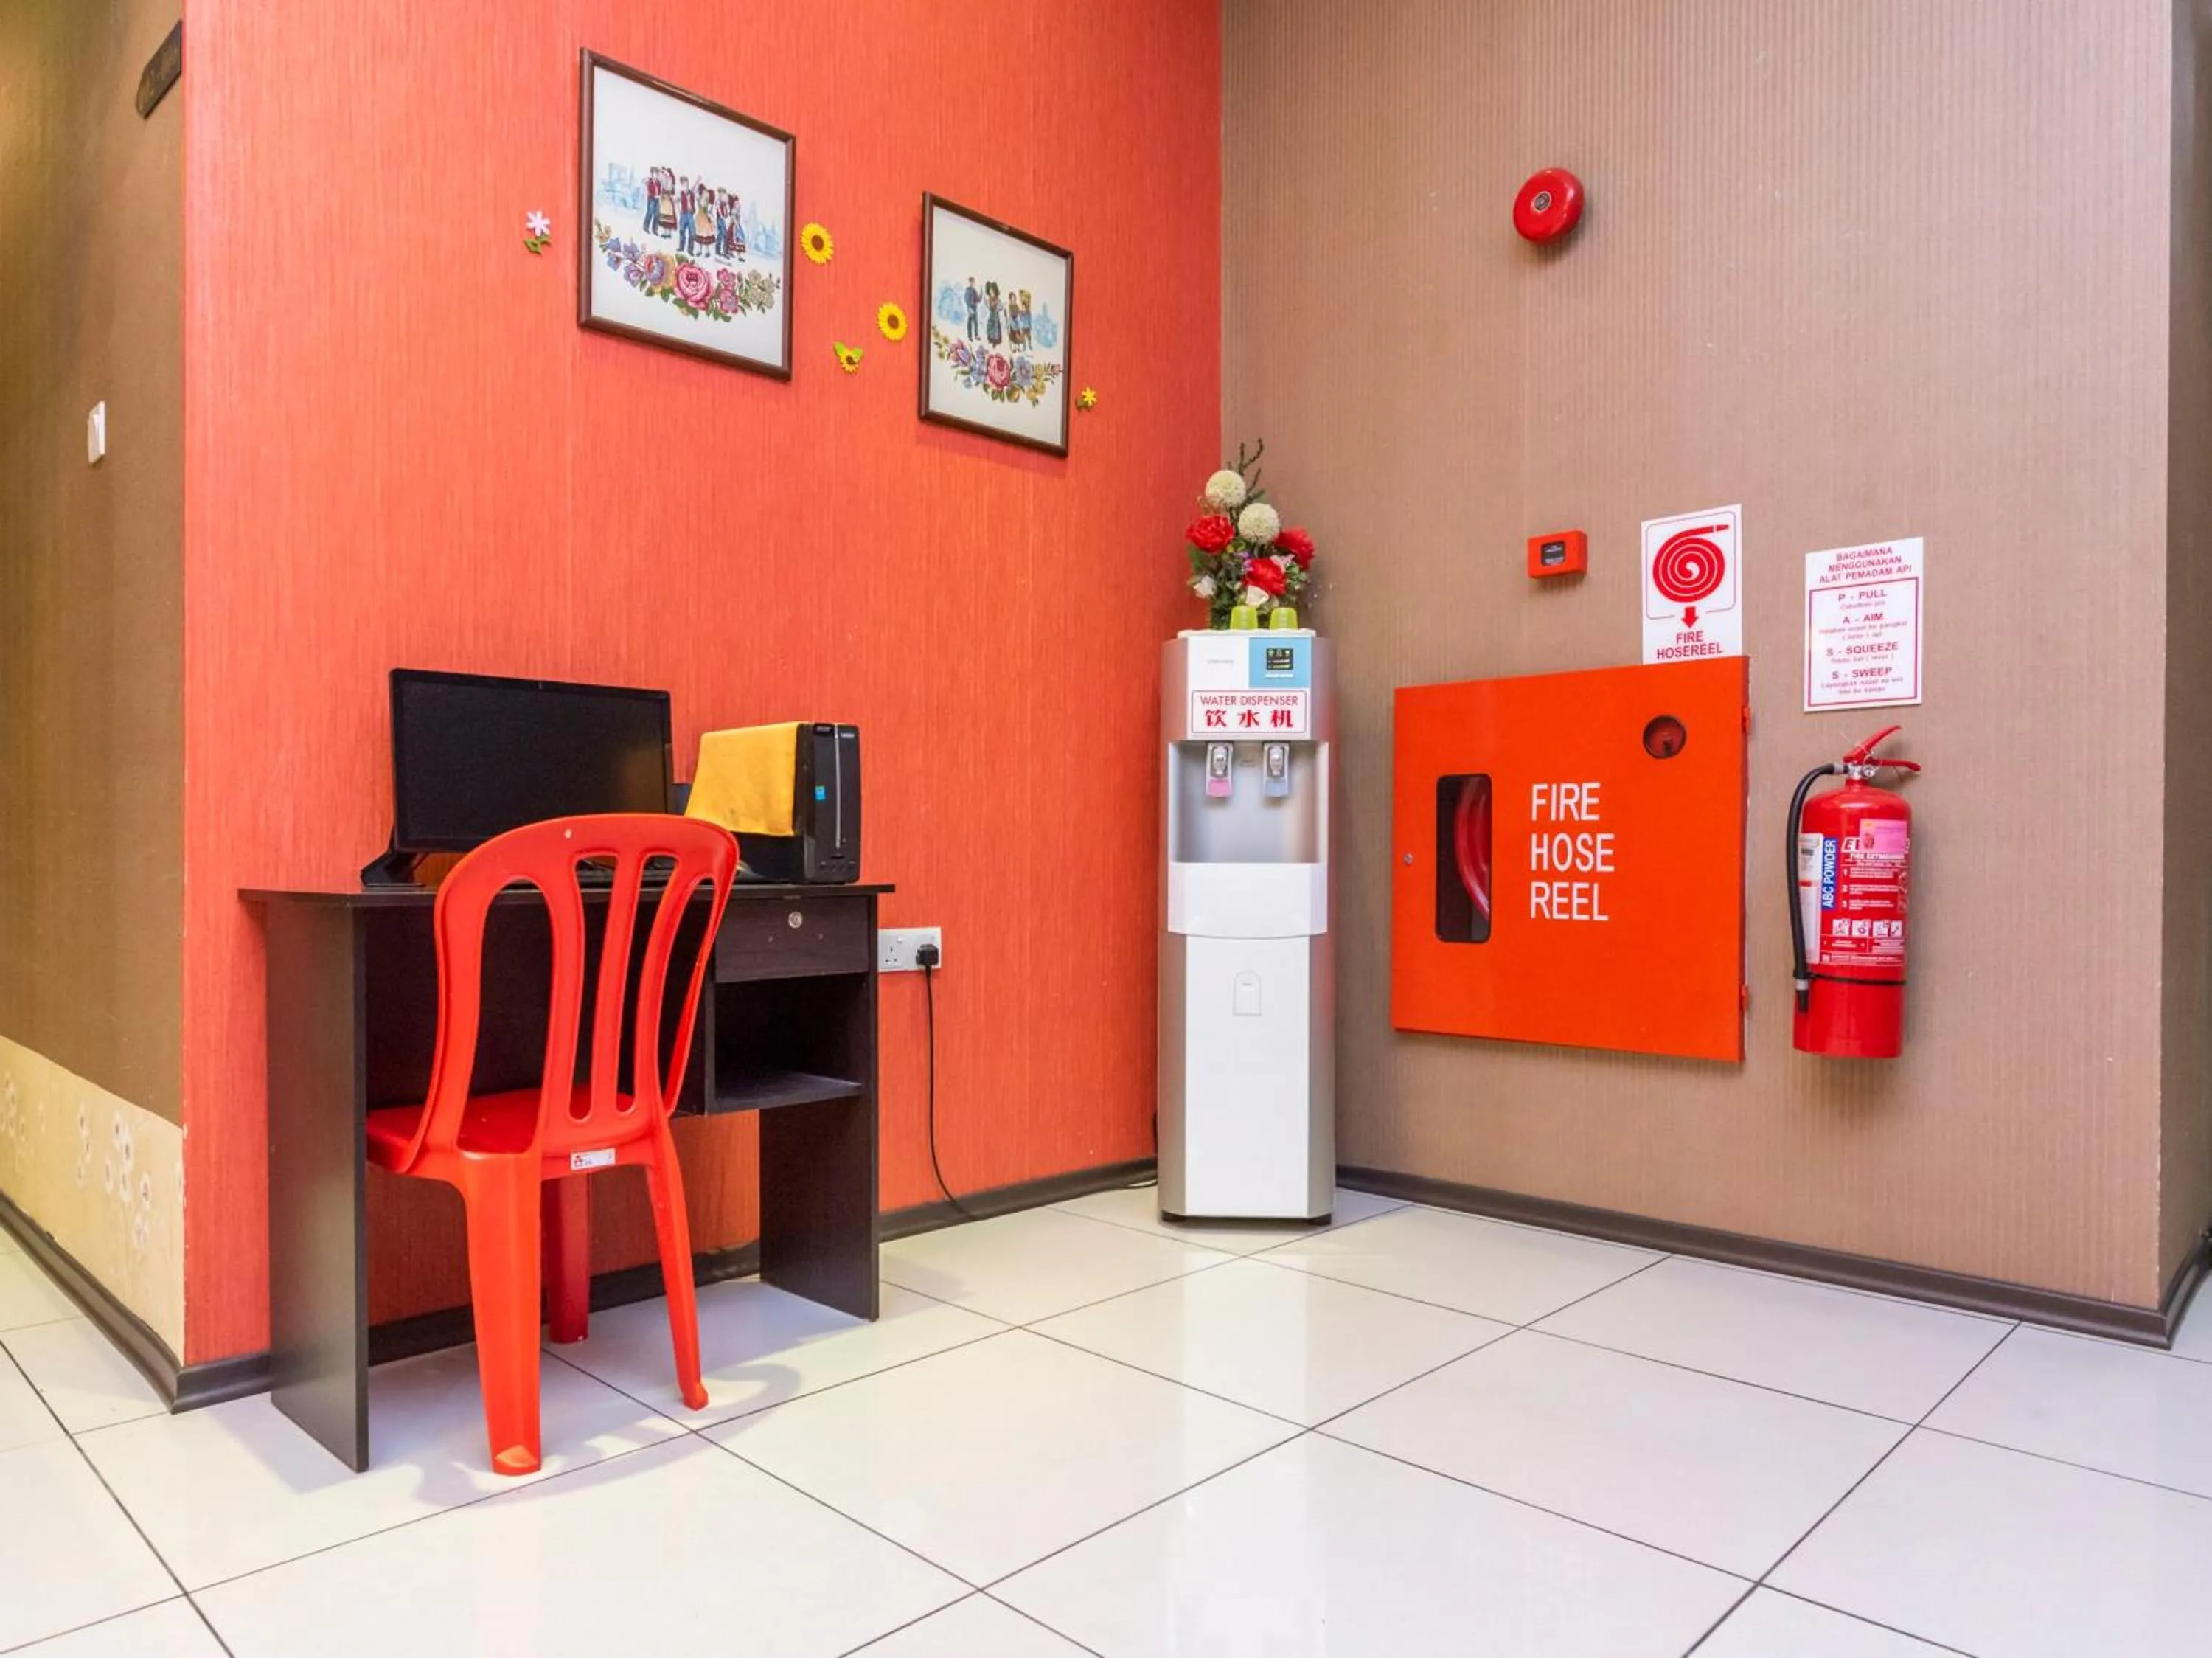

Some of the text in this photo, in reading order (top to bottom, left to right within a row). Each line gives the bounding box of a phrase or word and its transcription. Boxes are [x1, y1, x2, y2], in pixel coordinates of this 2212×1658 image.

[1836, 546, 1893, 561] BAGAIMANA
[1828, 555, 1902, 572] MENGGUNAKAN
[1819, 564, 1912, 583] ALAT PEMADAM API
[1838, 594, 1846, 602] P
[1858, 589, 1888, 600] PULL
[1843, 616, 1850, 624] A
[1863, 612, 1884, 622] AIM
[1675, 630, 1703, 644] FIRE
[1656, 642, 1723, 660] HOSEREEL
[1826, 648, 1834, 656] S
[1846, 641, 1899, 655] SQUEEZE
[1832, 670, 1840, 679] S
[1851, 666, 1893, 678] SWEEP
[1200, 696, 1298, 706] WATER DISPENSER
[1204, 709, 1293, 729] 饮水机
[1531, 781, 1601, 822] FIRE
[1531, 832, 1615, 873] HOSE
[1822, 839, 1837, 909] ABC POWDER
[1530, 881, 1610, 921] REEL
